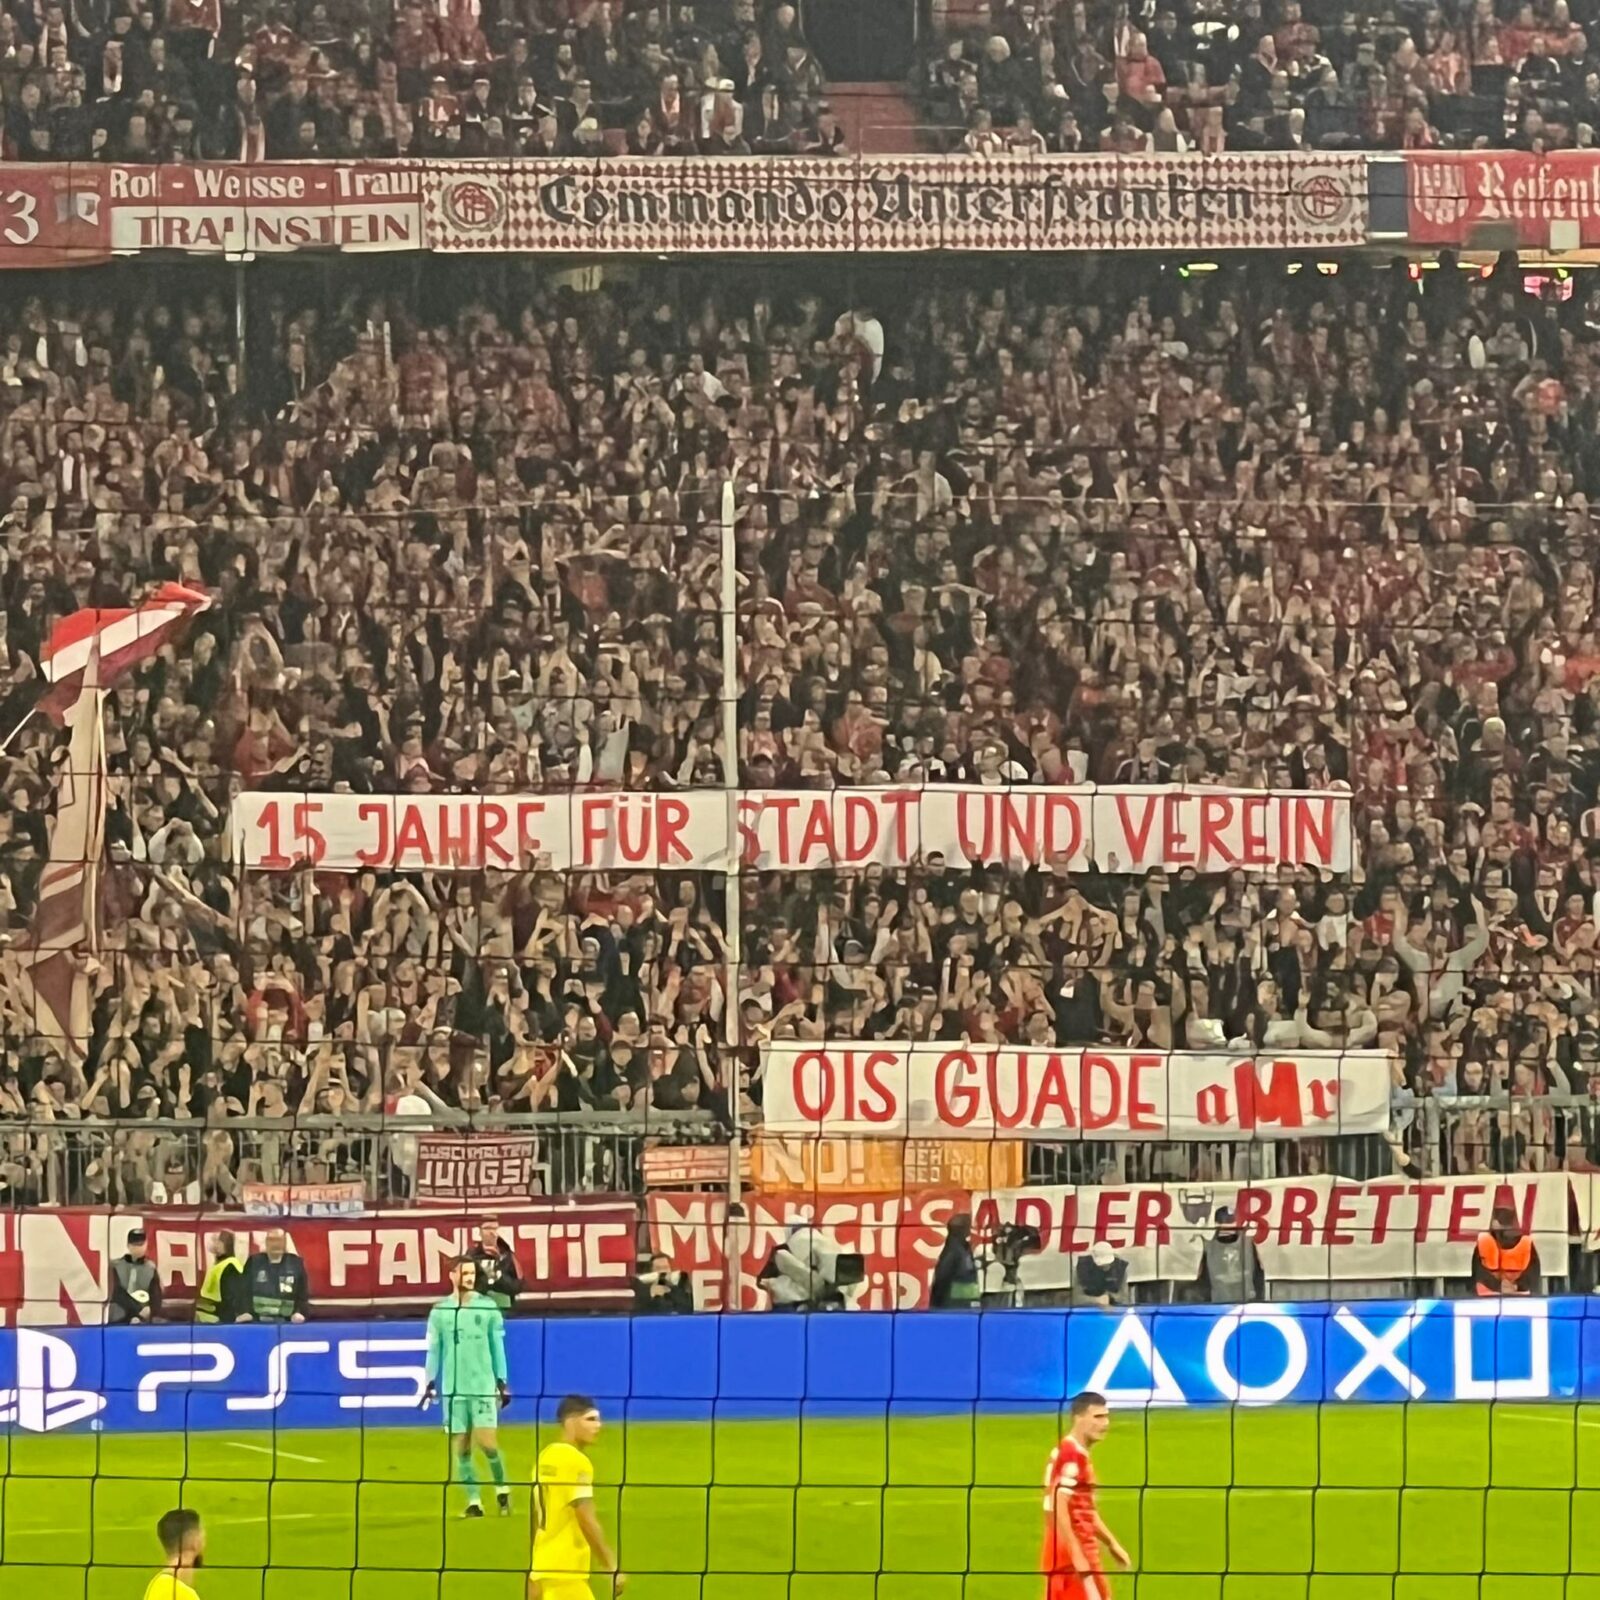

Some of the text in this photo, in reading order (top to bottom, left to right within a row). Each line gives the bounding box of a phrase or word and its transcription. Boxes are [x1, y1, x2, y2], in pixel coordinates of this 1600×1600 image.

[194, 168, 305, 199] Weisse
[540, 168, 1253, 236] Commando Unterfranken
[256, 790, 1334, 868] 15 JAHRE FÜR STADT UND VEREIN
[792, 1049, 899, 1122] OIS
[934, 1049, 1166, 1131] GUADE
[969, 1190, 1173, 1255] ADLER
[1235, 1184, 1538, 1247] BRETTEN
[136, 1339, 428, 1412] PS5
